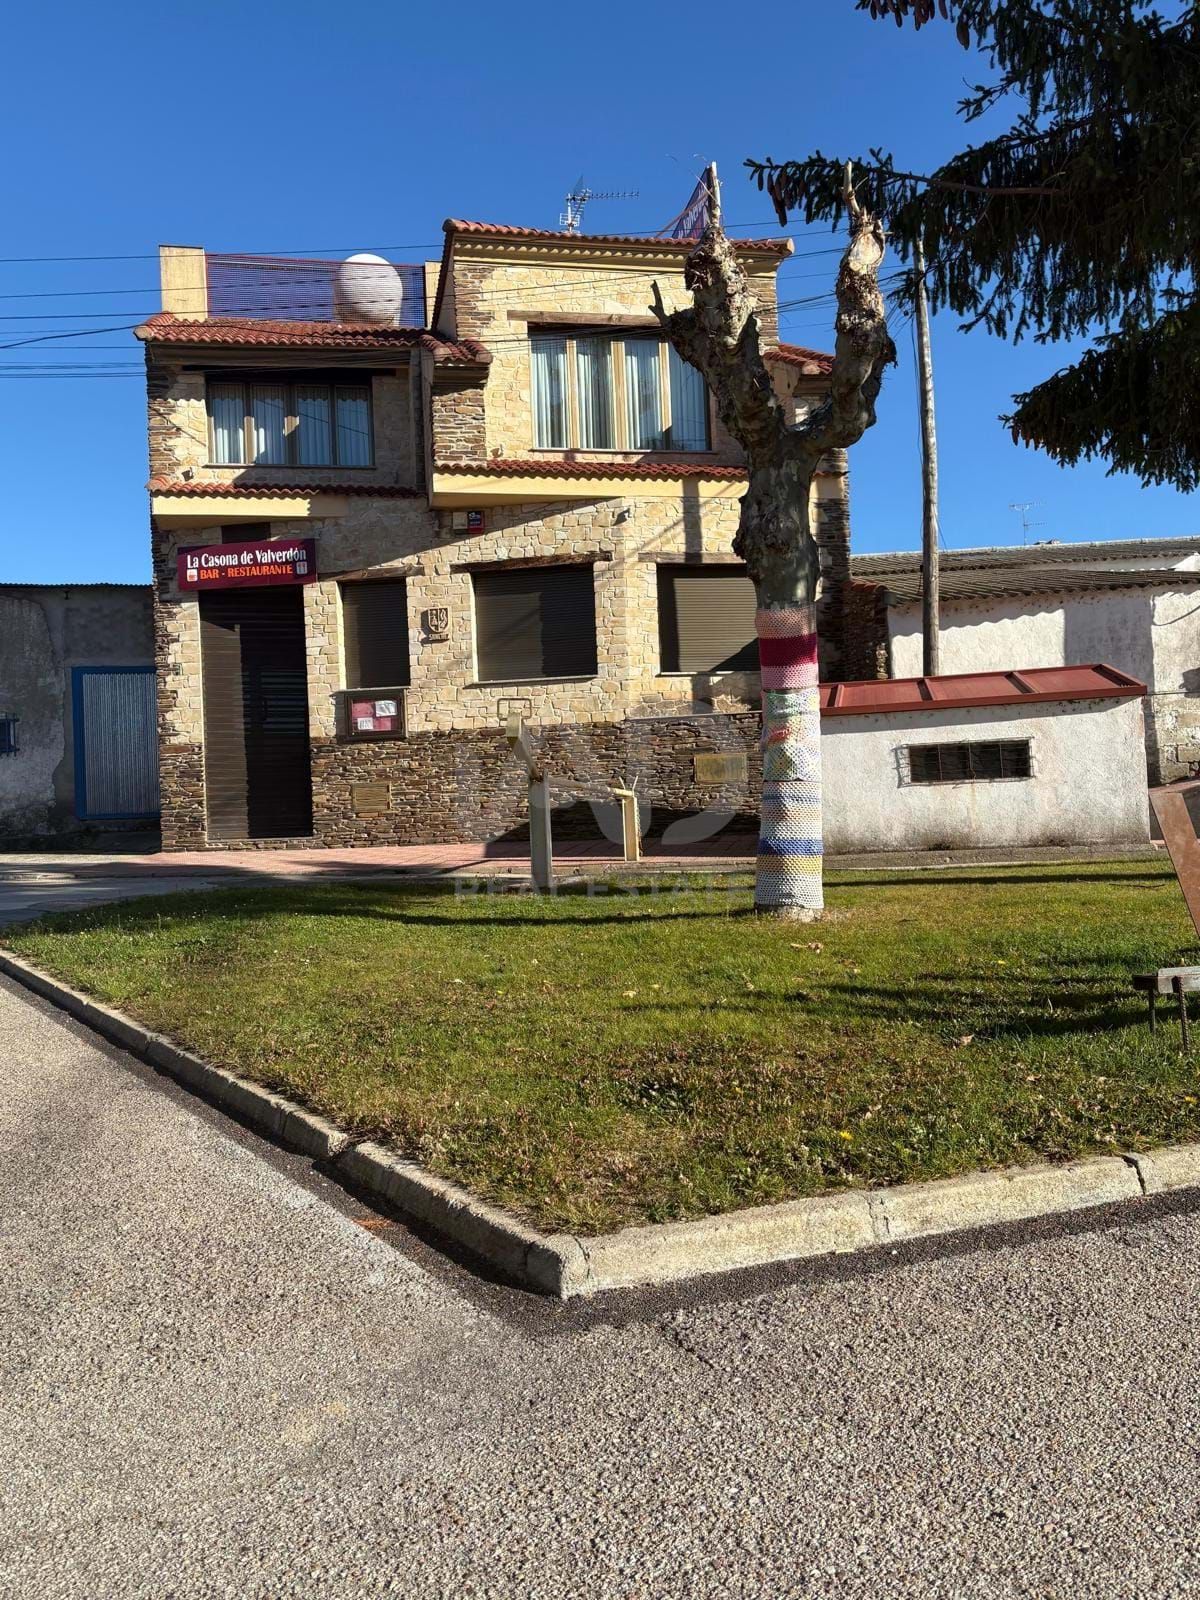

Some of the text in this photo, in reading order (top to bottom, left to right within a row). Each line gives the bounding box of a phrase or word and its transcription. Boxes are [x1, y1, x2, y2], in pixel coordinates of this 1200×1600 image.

[187, 547, 307, 569] La Casona de Valverdón
[200, 568, 220, 580] BAR
[227, 564, 293, 578] RESTAURANTE
